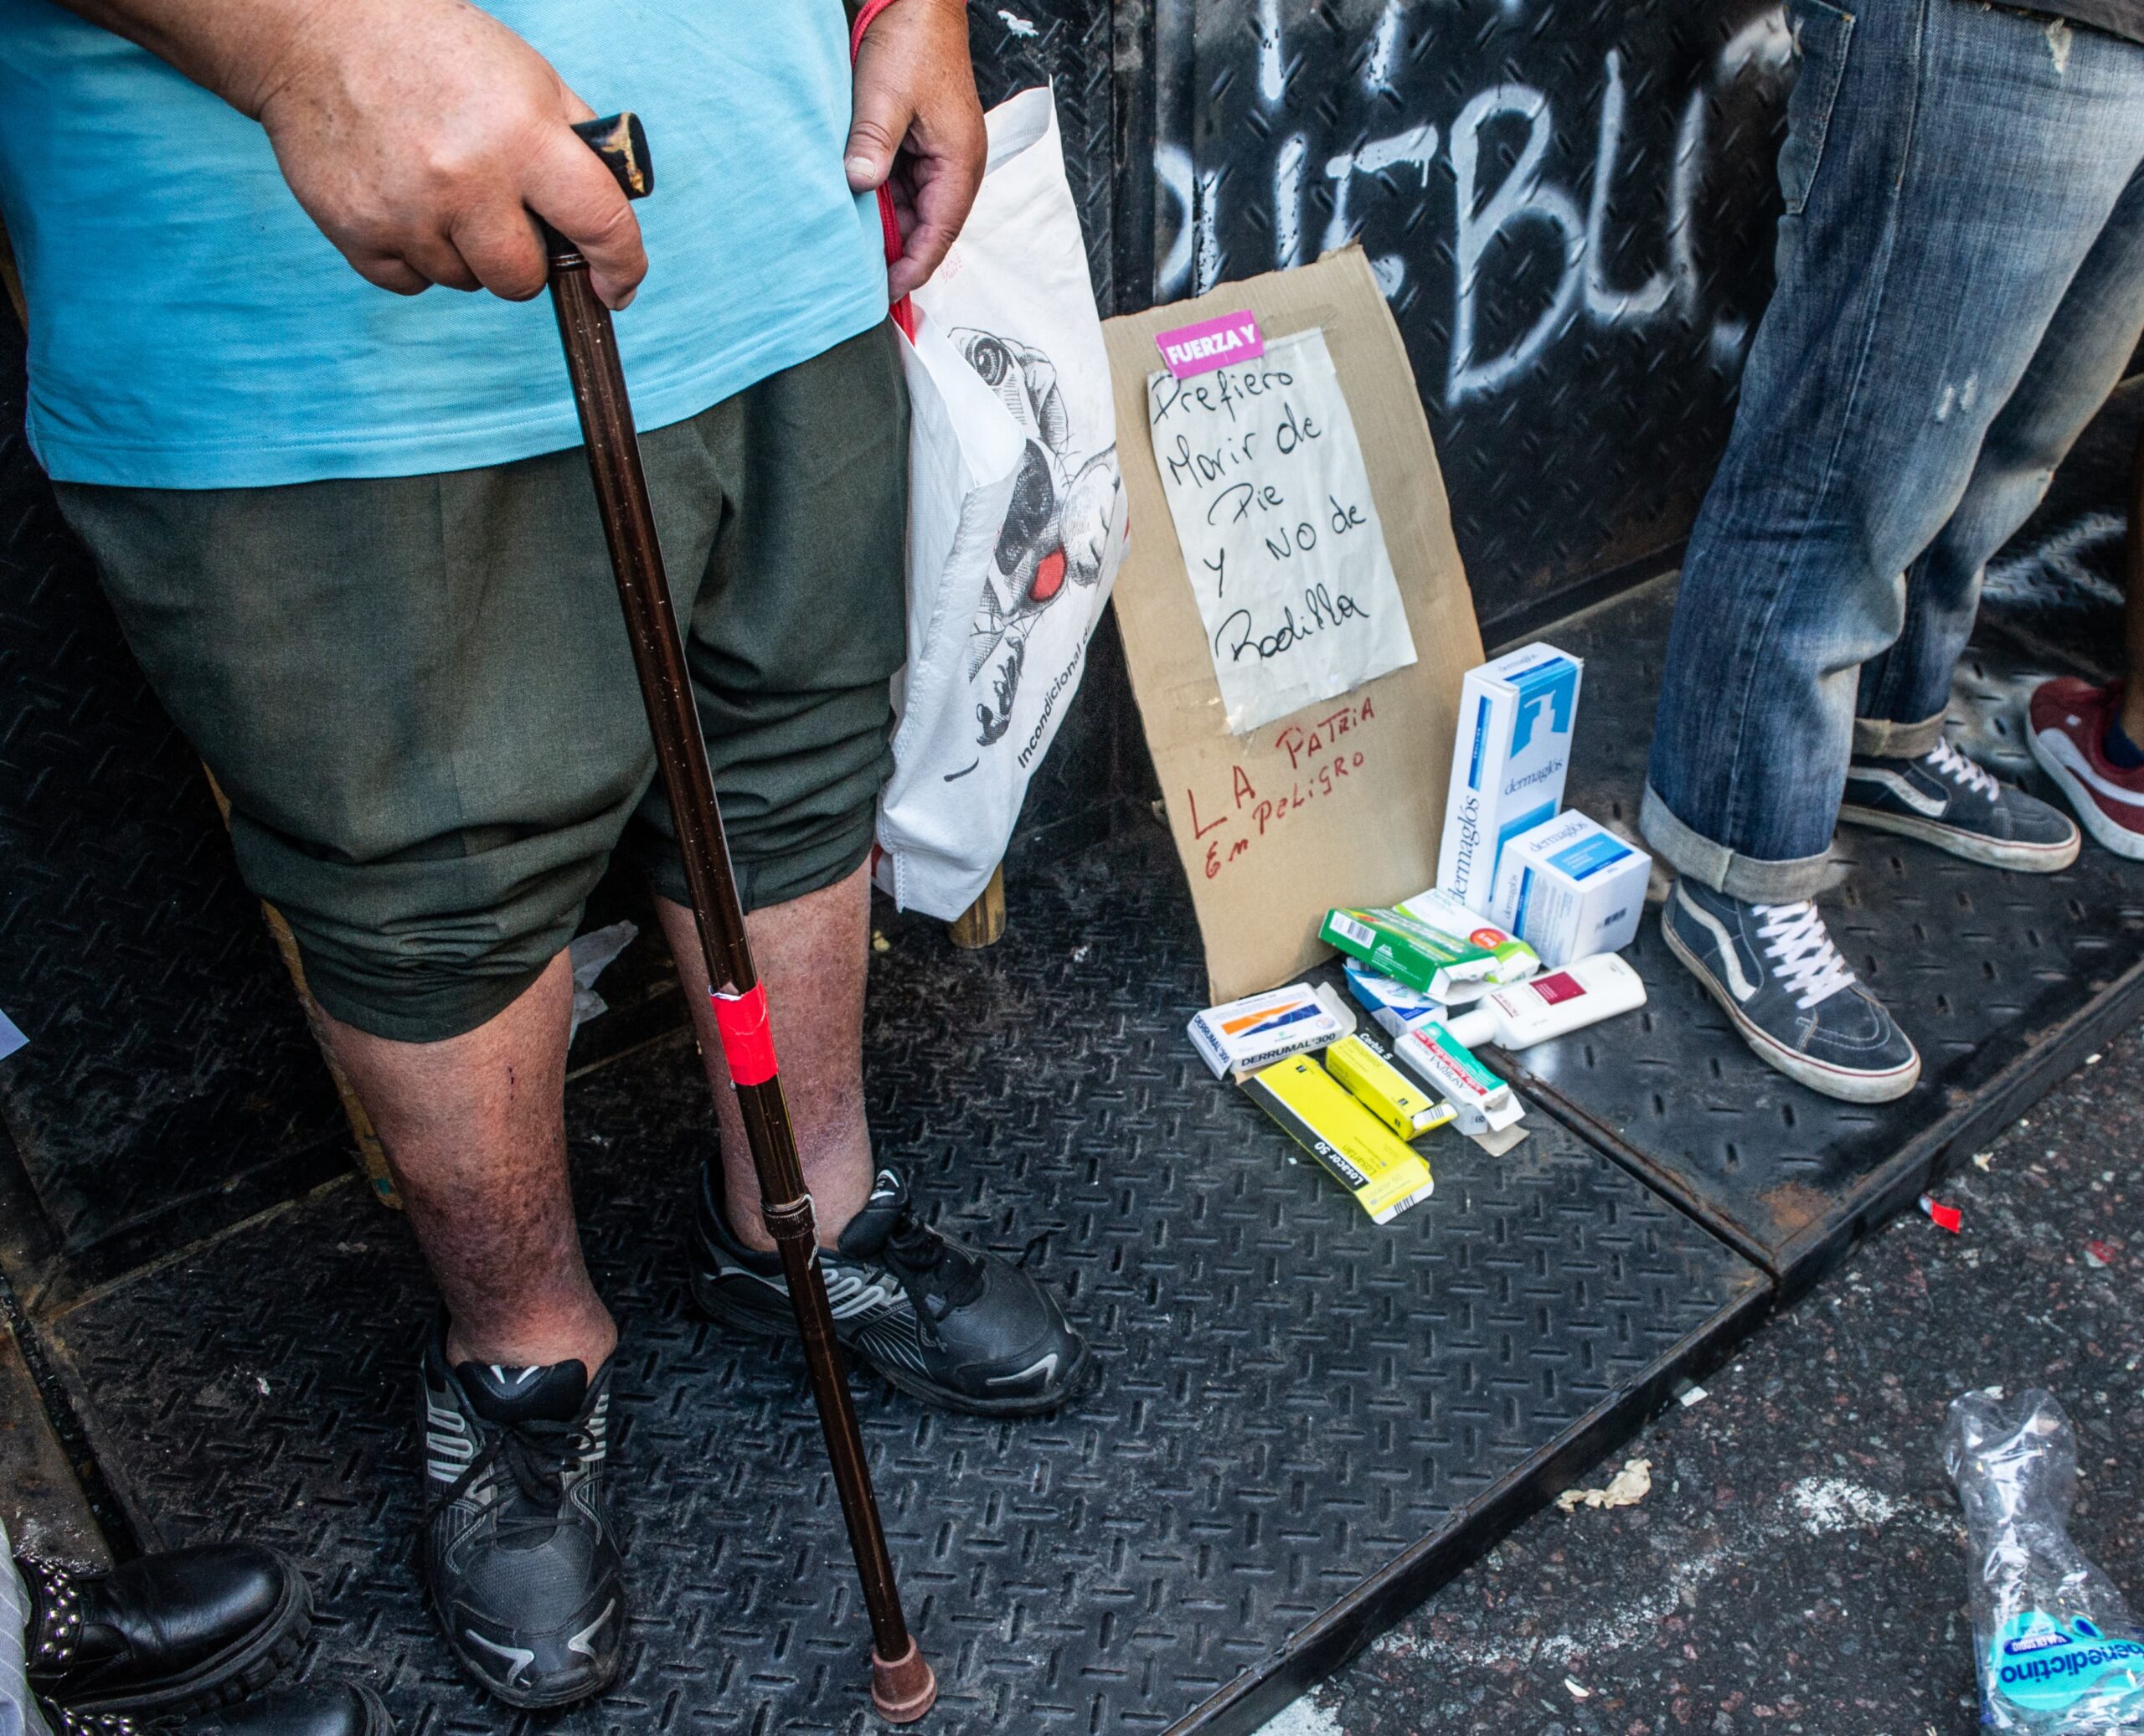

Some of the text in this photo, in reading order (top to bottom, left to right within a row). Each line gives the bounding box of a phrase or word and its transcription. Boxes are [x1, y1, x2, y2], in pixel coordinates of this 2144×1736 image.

[1166, 323, 1255, 365] FUERZA Y
[1151, 370, 1293, 425] Prefiero
[1167, 402, 1322, 488] Morir de
[1208, 482, 1284, 525] Pie
[1265, 523, 1316, 561] NO
[1331, 495, 1367, 535] de
[1215, 582, 1370, 662] Rodilla
[1018, 642, 1081, 769] Incondicional
[1193, 1015, 1230, 1064] DERRUMAL 300
[1240, 1040, 1312, 1068] DERRUMAL
[1315, 1033, 1337, 1045] 300
[1359, 1033, 1385, 1058] Corbis
[1383, 1052, 1394, 1061] 5
[1314, 1141, 1331, 1155] 50
[1329, 1151, 1364, 1186] Losacor
